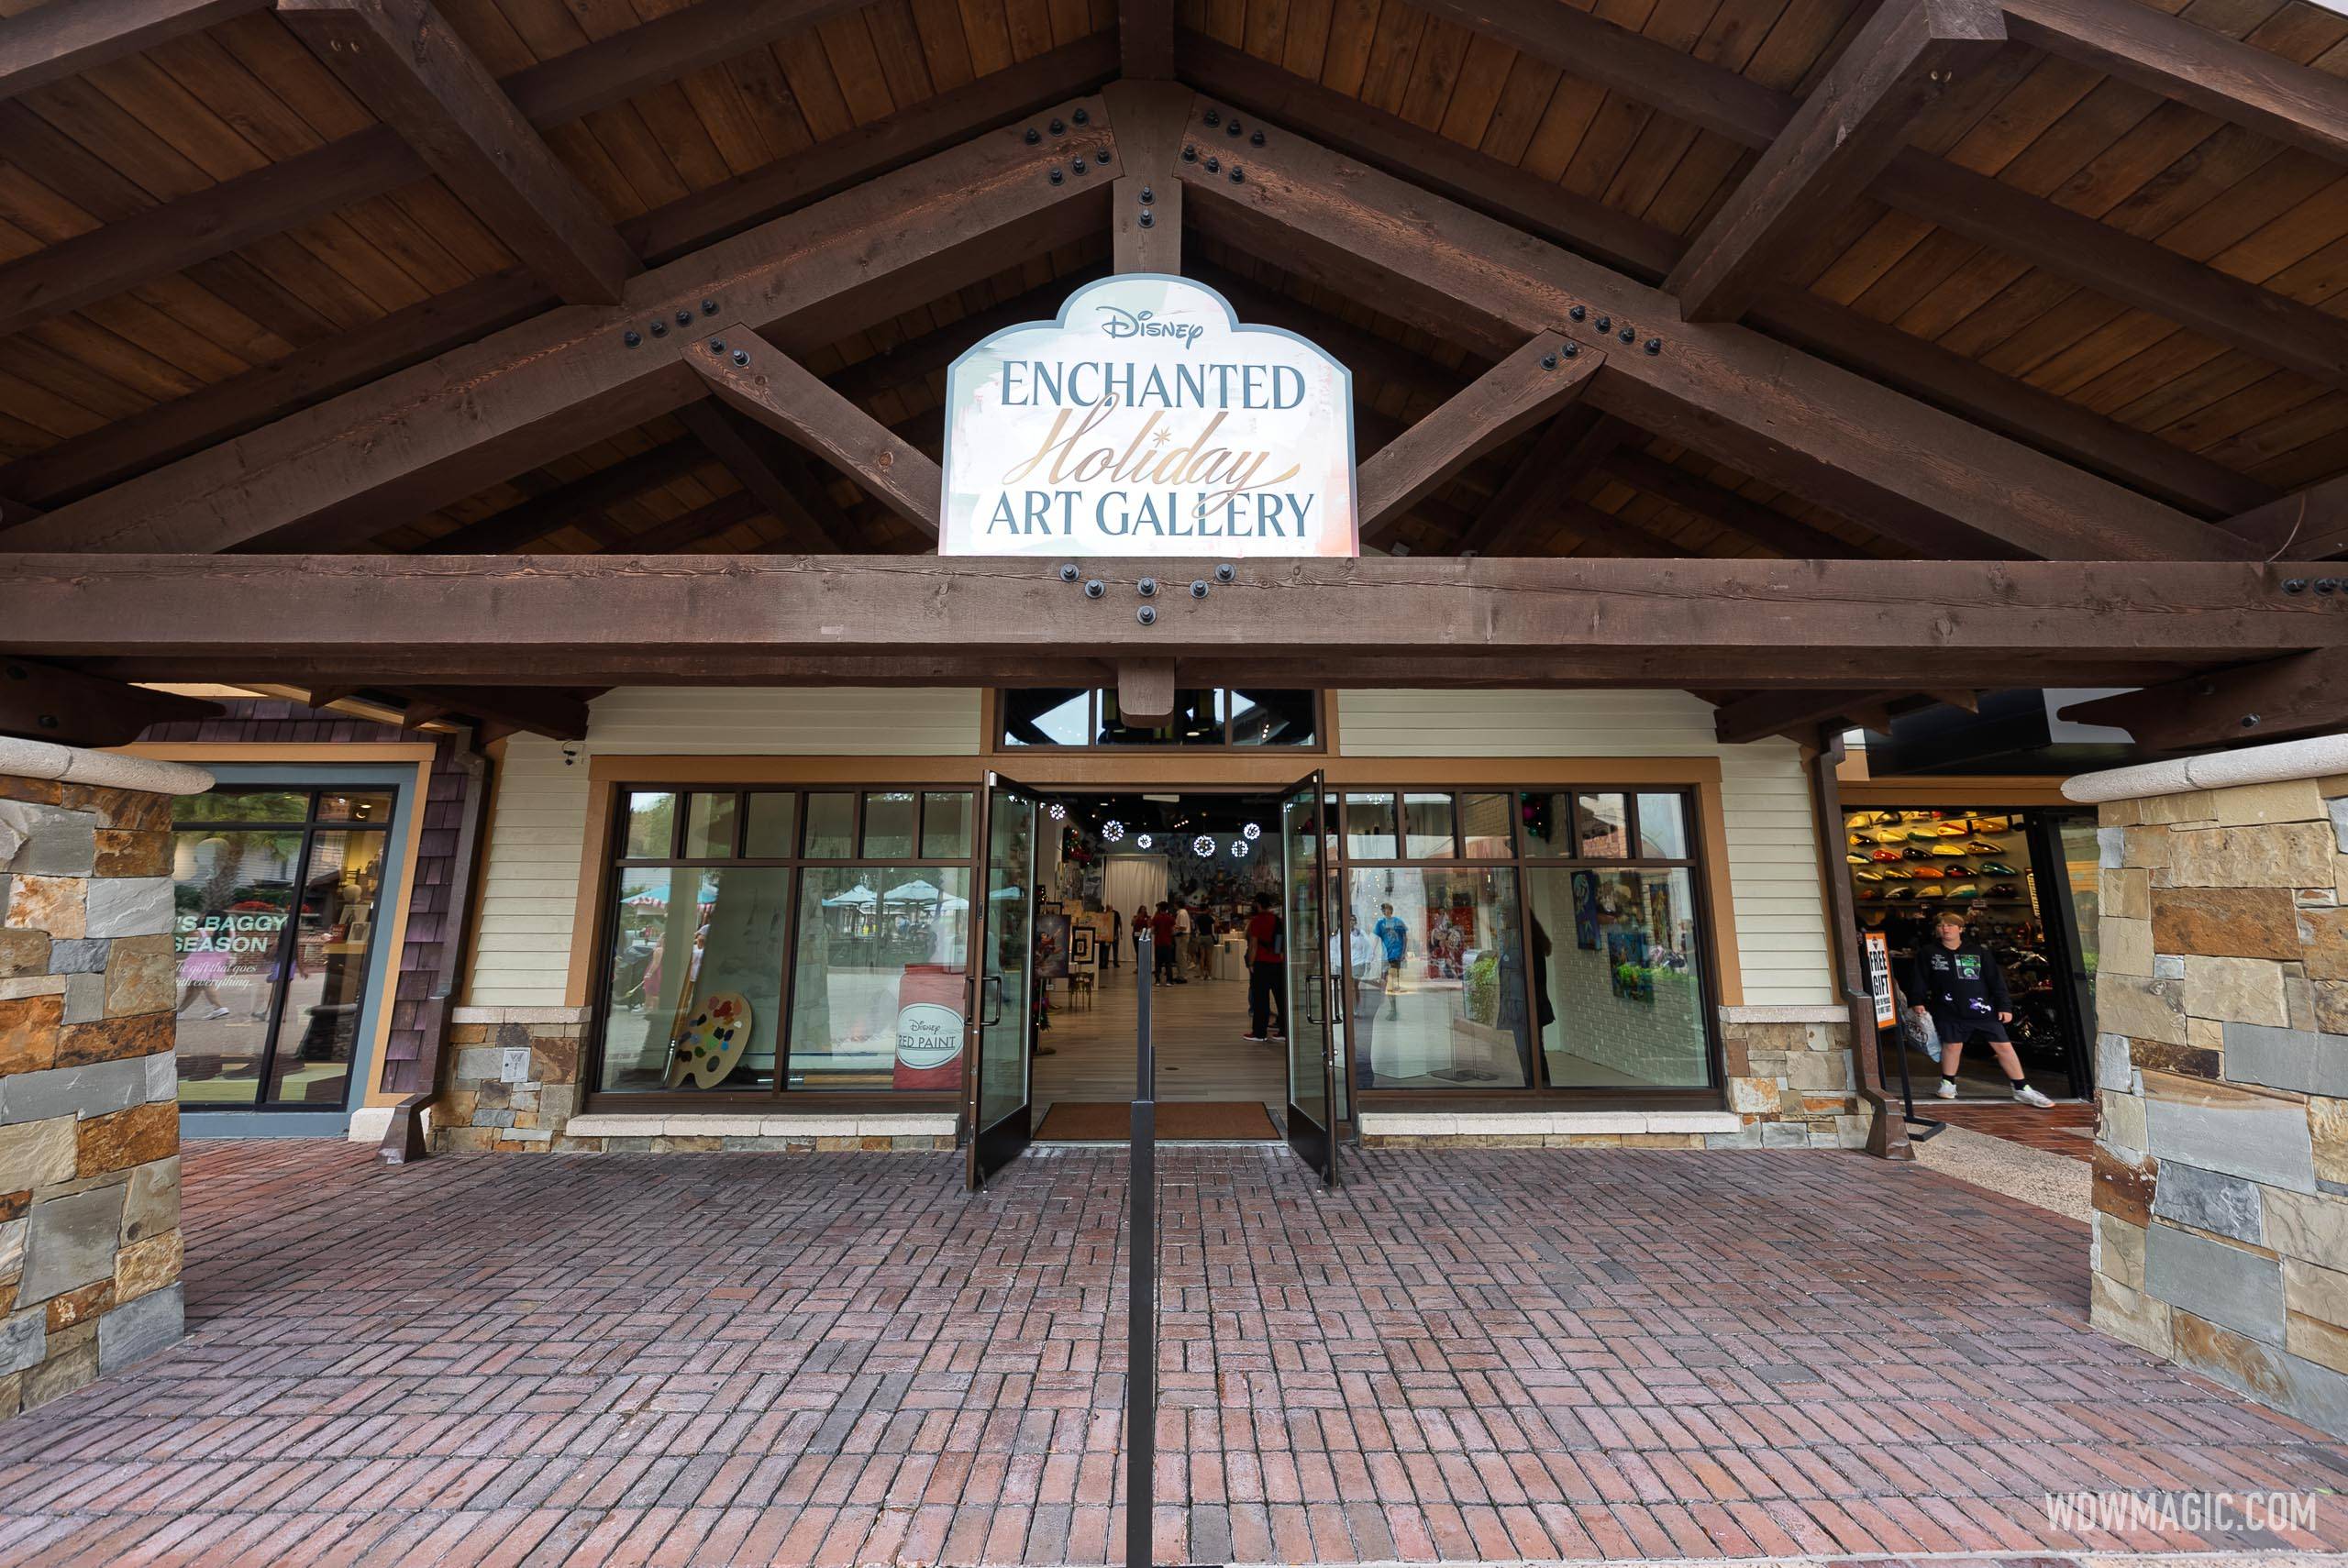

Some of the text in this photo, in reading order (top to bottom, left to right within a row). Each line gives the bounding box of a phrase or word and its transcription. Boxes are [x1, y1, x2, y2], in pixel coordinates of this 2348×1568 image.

[1095, 305, 1203, 349] Disney
[1001, 359, 1306, 410] ENCHANTED
[1002, 392, 1301, 519] Holiday
[986, 490, 1315, 537] ART GALLERY
[204, 914, 290, 932] BAGGY
[189, 961, 210, 979] gift
[209, 960, 232, 973] that
[232, 965, 258, 977] goes
[1869, 950, 1888, 972] FREE
[1873, 974, 1889, 996] GIFT
[909, 1020, 941, 1034] Disney
[919, 1036, 956, 1049] PAINT
